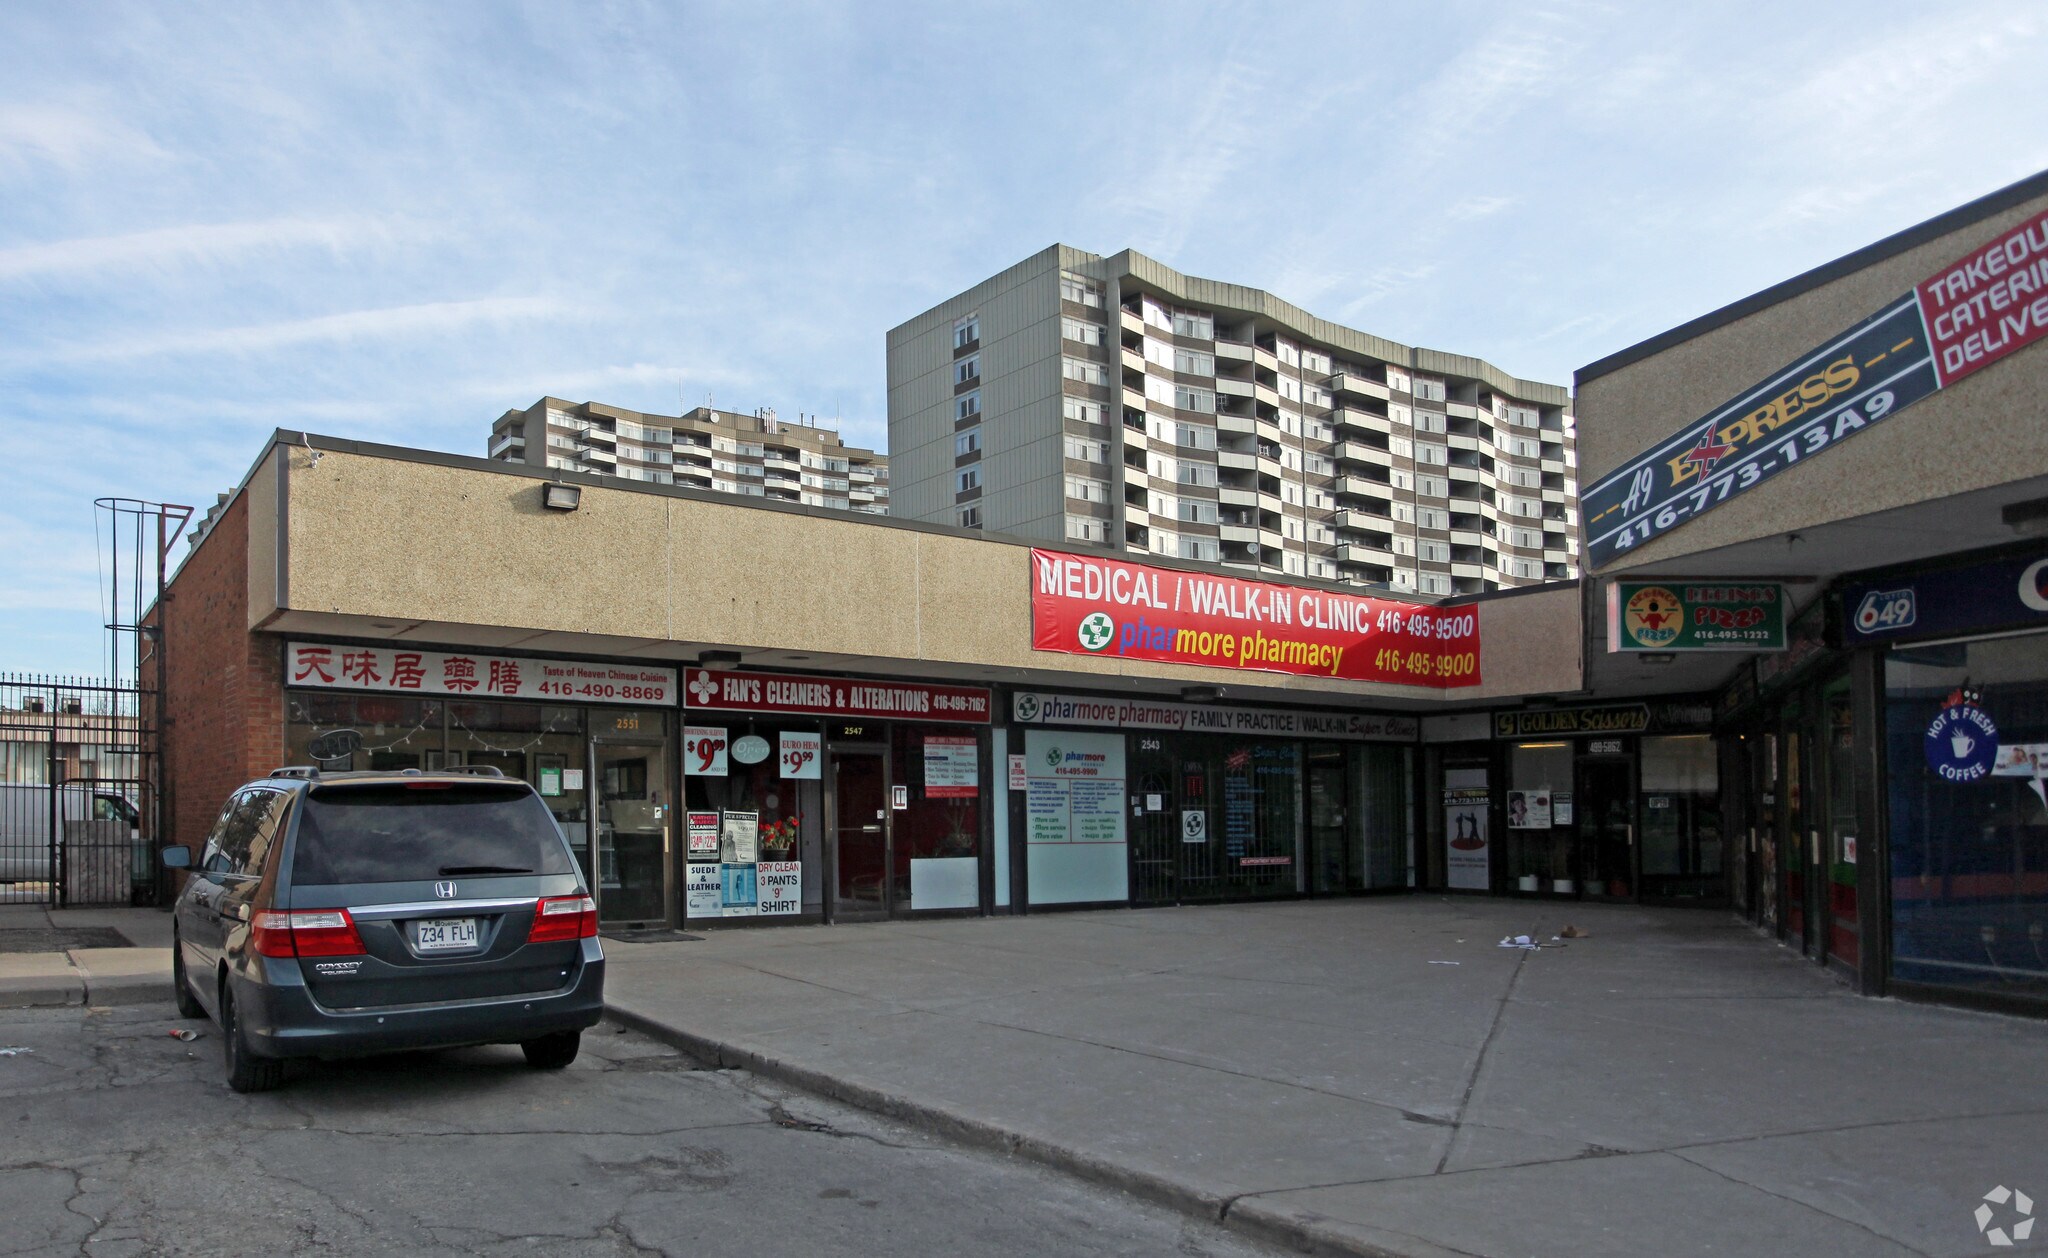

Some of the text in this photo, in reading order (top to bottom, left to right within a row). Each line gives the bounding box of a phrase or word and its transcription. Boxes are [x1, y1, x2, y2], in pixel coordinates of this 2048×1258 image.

[1620, 355, 1861, 517] A9 EXPRESS
[1613, 390, 1895, 550] 416-773-13A9
[1040, 556, 1168, 610] MEDICAL
[1174, 576, 1183, 612] /
[1189, 578, 1292, 625] WALK-IN
[1299, 595, 1369, 635] CLINIC
[1694, 606, 1766, 629] PIZZA
[1636, 626, 1676, 642] PIZZA
[1694, 630, 1769, 640] 416-495-1222
[1119, 617, 1344, 676] pharmore pharmacy
[543, 665, 668, 683] Taste of Heaven Chinese Cuisine
[538, 681, 664, 701] 416-490-8869
[723, 677, 986, 712] FAN'S CLEANERS & ALTERATIONS 416-496-7162
[617, 718, 639, 730] 2551
[1042, 697, 1116, 723] pharmore
[1118, 702, 1189, 731] pharmacy
[1191, 710, 1234, 730] FAMILY
[1237, 712, 1294, 732] PRACTICE
[1302, 717, 1347, 734] WALK-IN
[1348, 716, 1381, 738] Super
[1385, 718, 1416, 737] Clinic
[1520, 710, 1578, 732] GOLDEN
[1580, 709, 1645, 731] Scissors
[1927, 707, 1996, 739] HOT & FRESH
[844, 727, 863, 735] 2547
[782, 740, 819, 750] EURO HEM
[1141, 740, 1160, 751] 2543
[1065, 750, 1106, 763] pharmore
[1055, 767, 1099, 776] 416-495-9900
[1938, 762, 1986, 781] COFFEE
[691, 866, 716, 874] SUEDE
[758, 863, 773, 873] DRY
[775, 862, 799, 872] CLEAN
[687, 883, 721, 891] LEATHER
[761, 875, 798, 886] 3 PANTS
[761, 900, 798, 913] SHIRT
[420, 925, 475, 943] Z34 FLH
[315, 961, 364, 971] ODYSSEY
